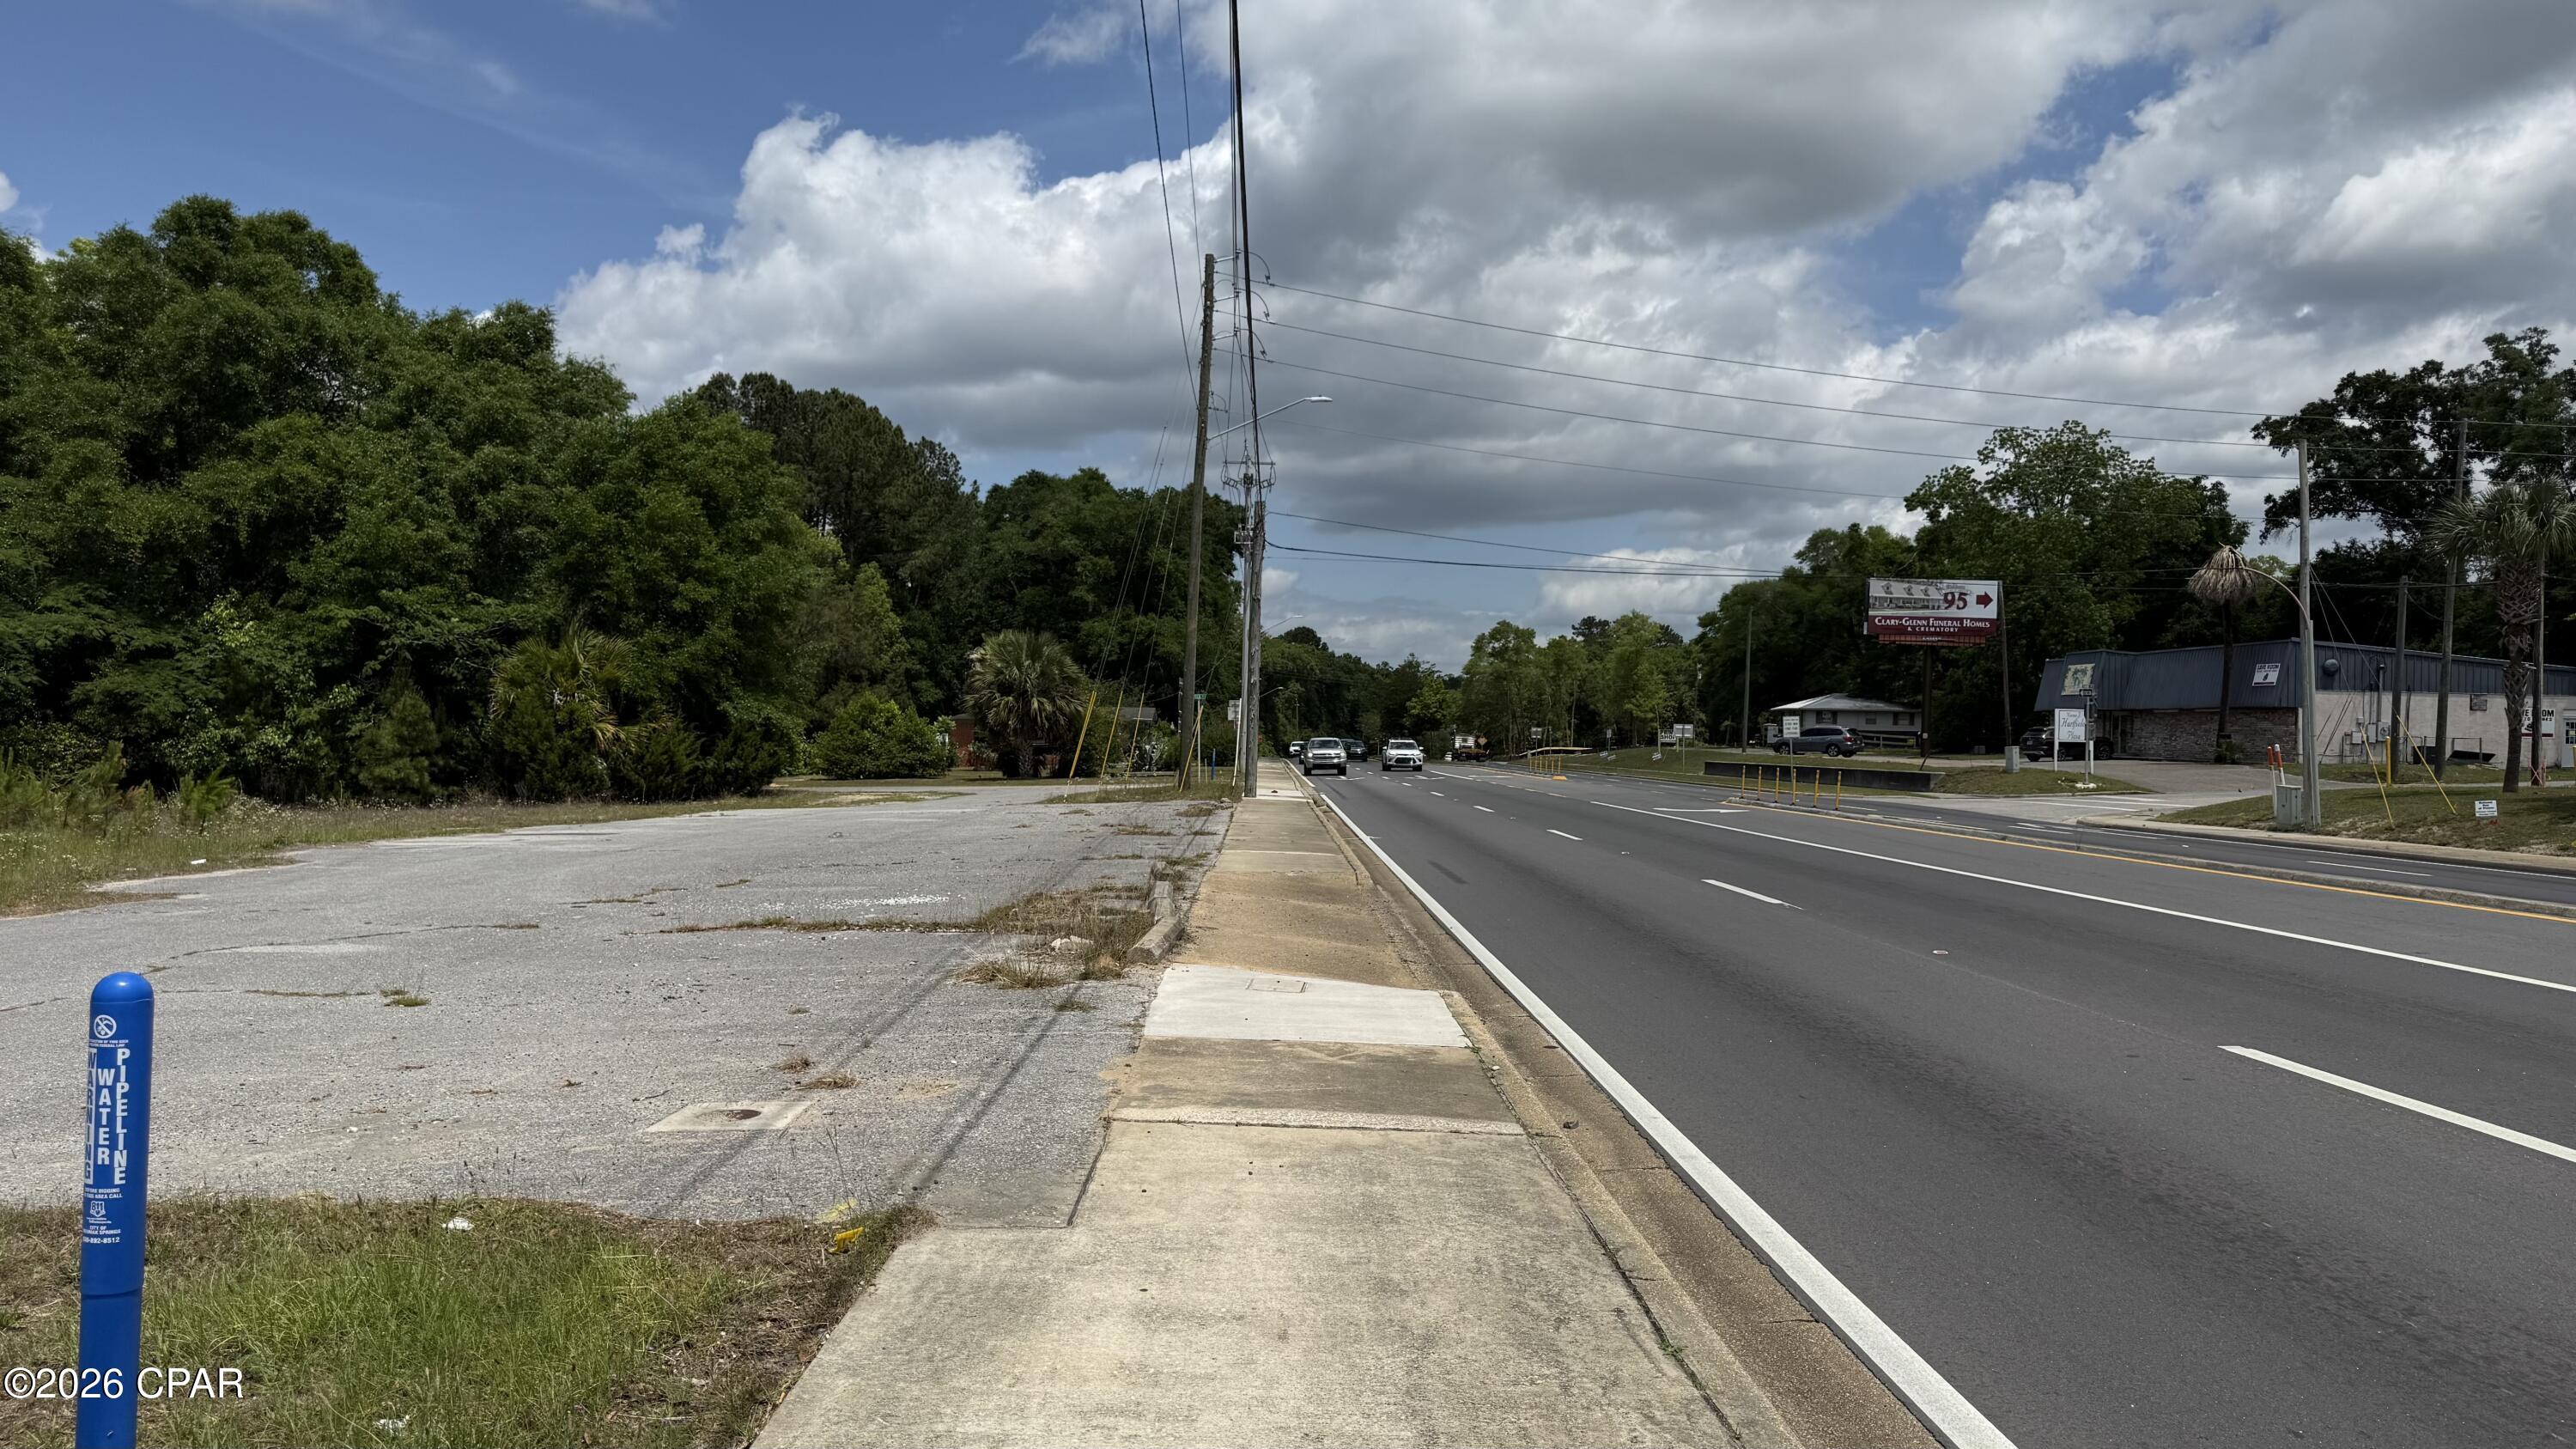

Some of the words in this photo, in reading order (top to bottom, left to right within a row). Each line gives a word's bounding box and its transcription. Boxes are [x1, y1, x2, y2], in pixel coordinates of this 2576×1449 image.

[1943, 592, 1969, 610] 95
[1874, 617, 1928, 626] CLARY-GLENN
[1929, 618, 1961, 627] FUNERAL
[1963, 618, 1990, 628] HOMES
[97, 1068, 115, 1165] WATER
[114, 1048, 131, 1184] PIPELINE
[91, 1202, 104, 1211] 811
